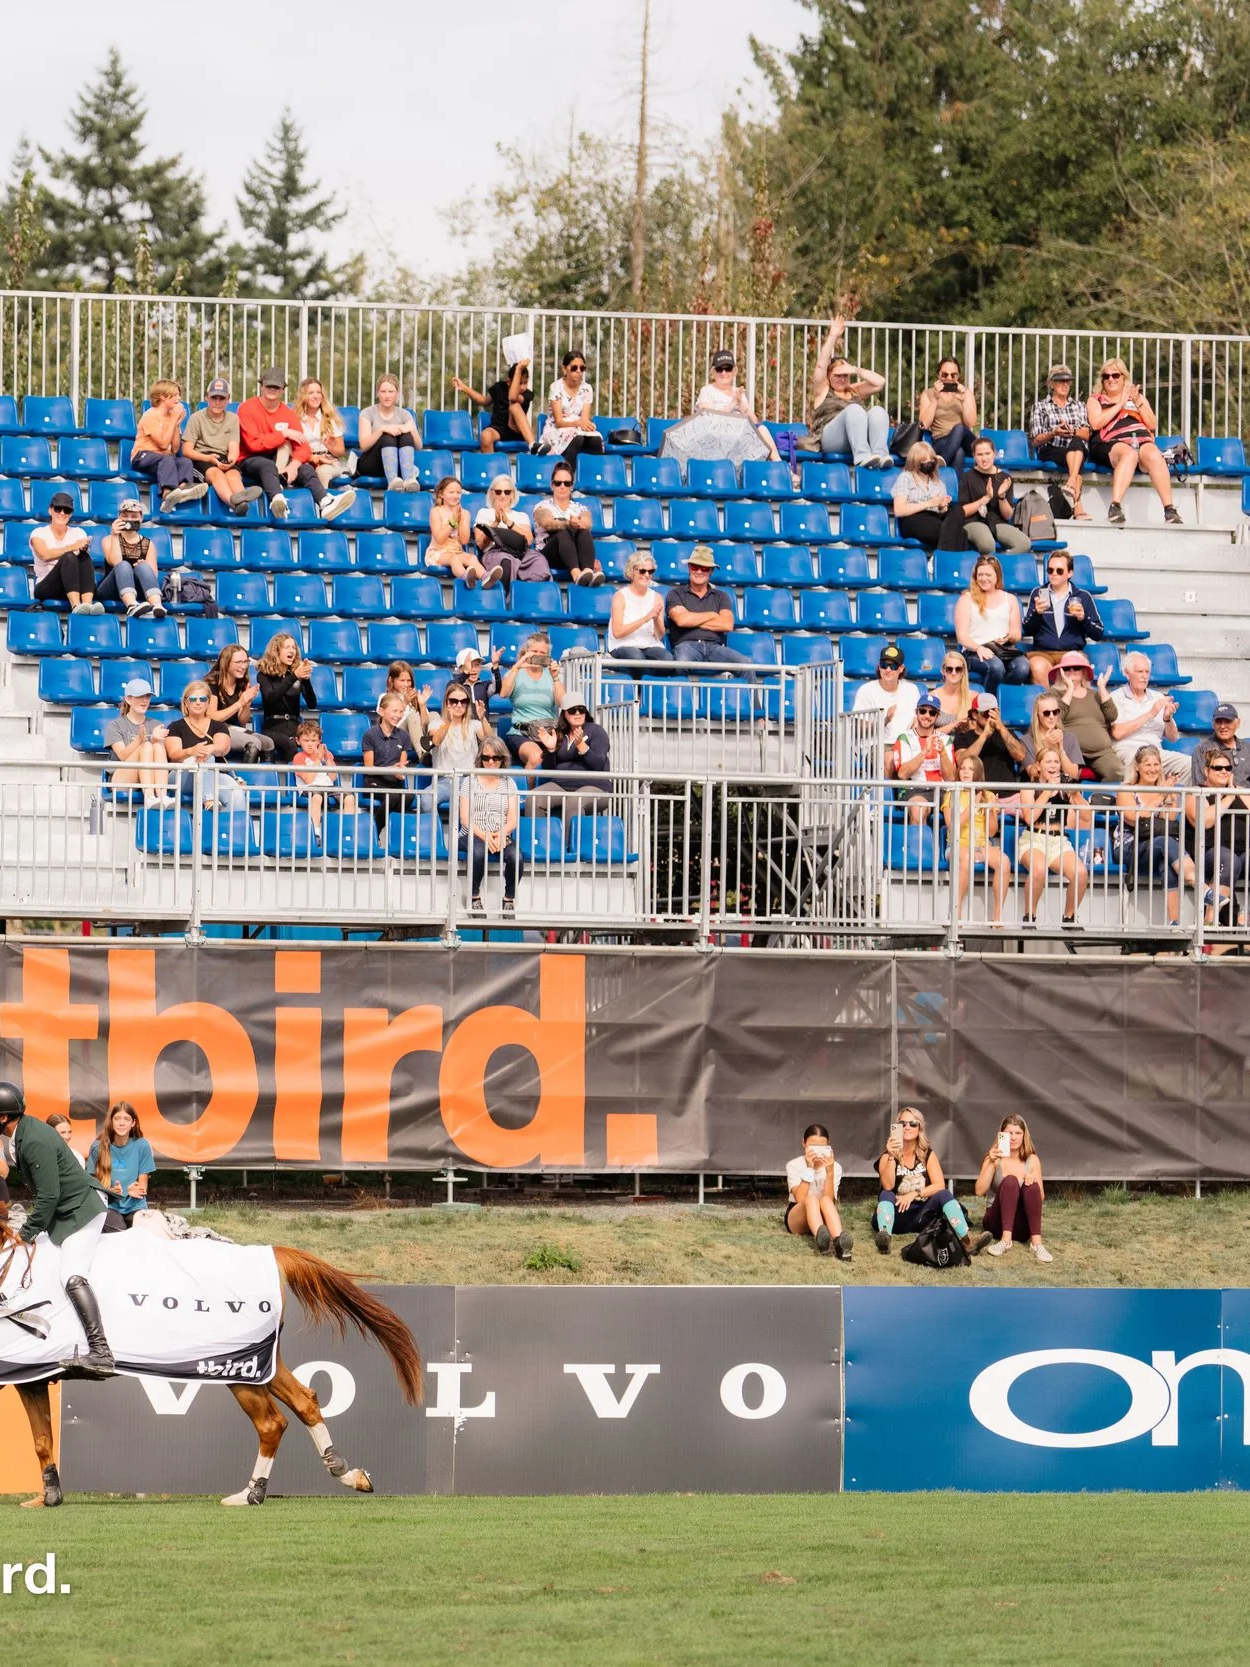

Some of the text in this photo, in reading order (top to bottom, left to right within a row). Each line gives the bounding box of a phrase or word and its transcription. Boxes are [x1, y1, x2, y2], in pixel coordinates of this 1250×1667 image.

[0, 948, 658, 1168] tbird.
[128, 1293, 272, 1313] VOLVO
[196, 1355, 261, 1379] tbird.
